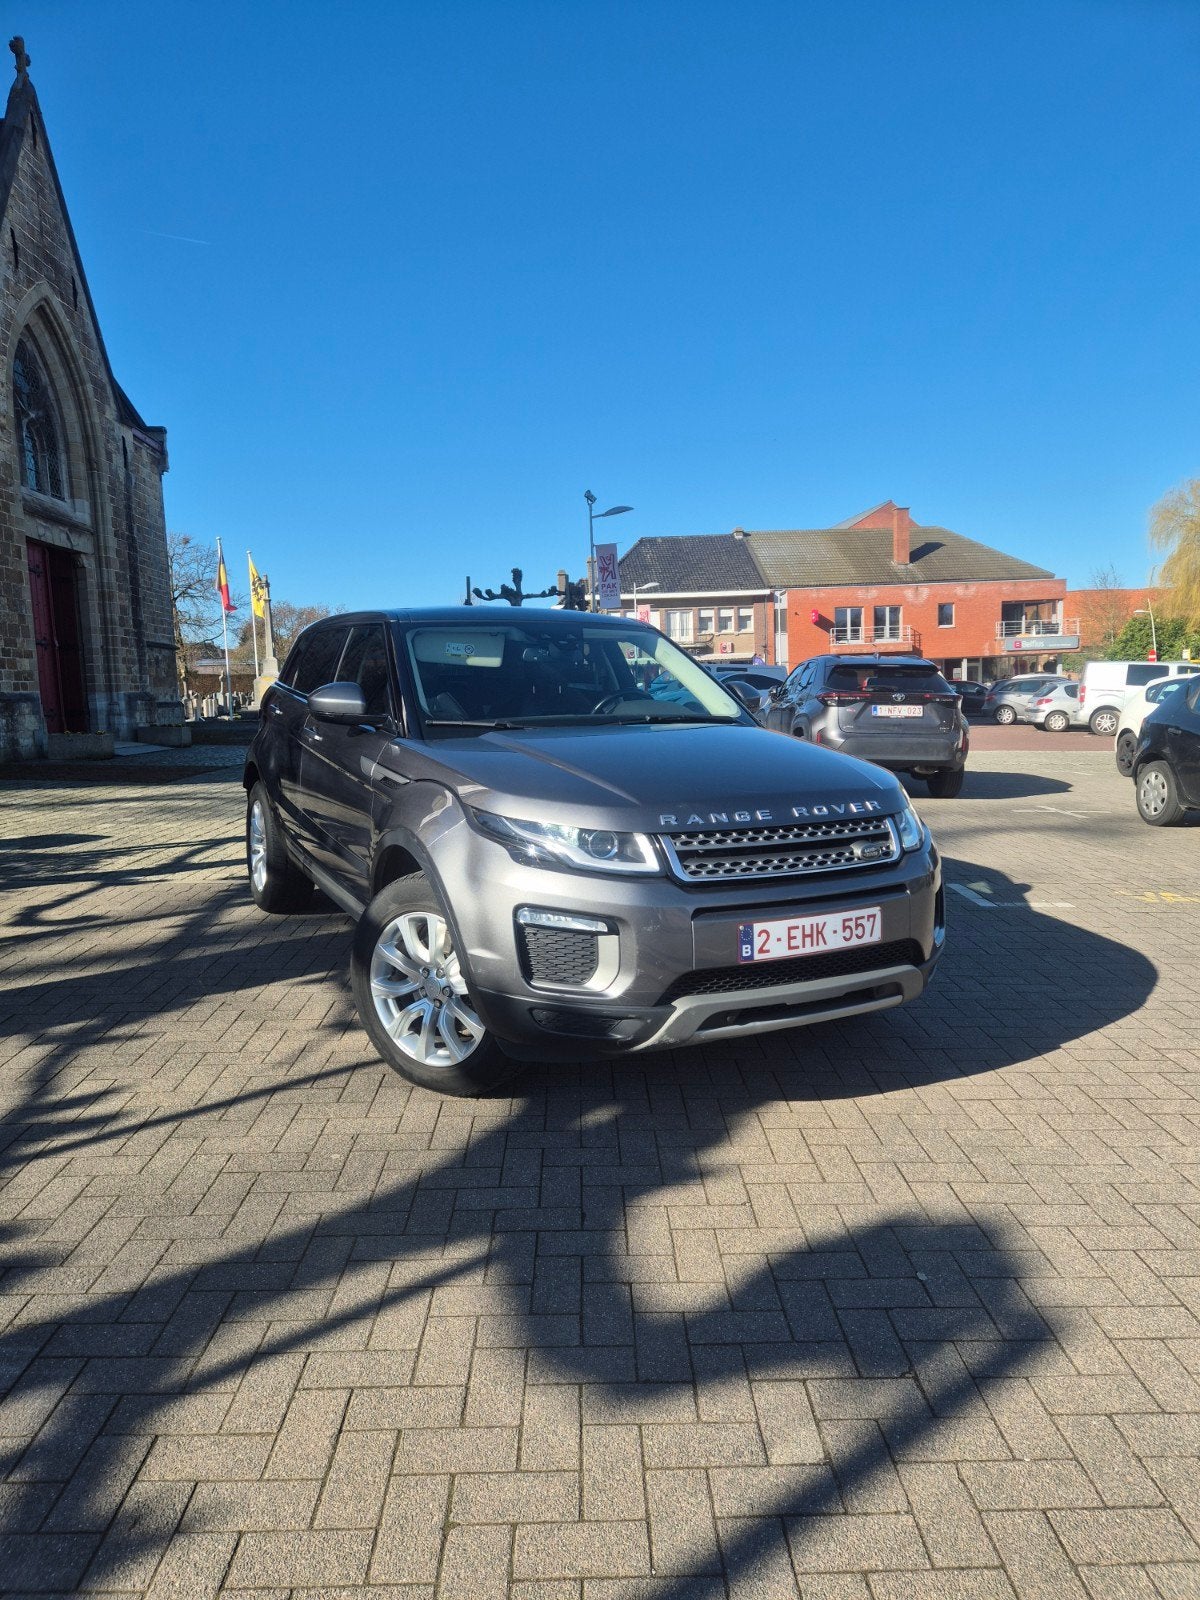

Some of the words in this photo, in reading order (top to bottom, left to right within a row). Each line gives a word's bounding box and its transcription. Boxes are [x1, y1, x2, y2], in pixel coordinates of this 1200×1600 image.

[601, 582, 617, 590] PAK
[660, 809, 773, 826] RANGE
[792, 800, 882, 818] ROVER
[757, 913, 877, 954] 2-EHK-557
[742, 944, 752, 957] B
